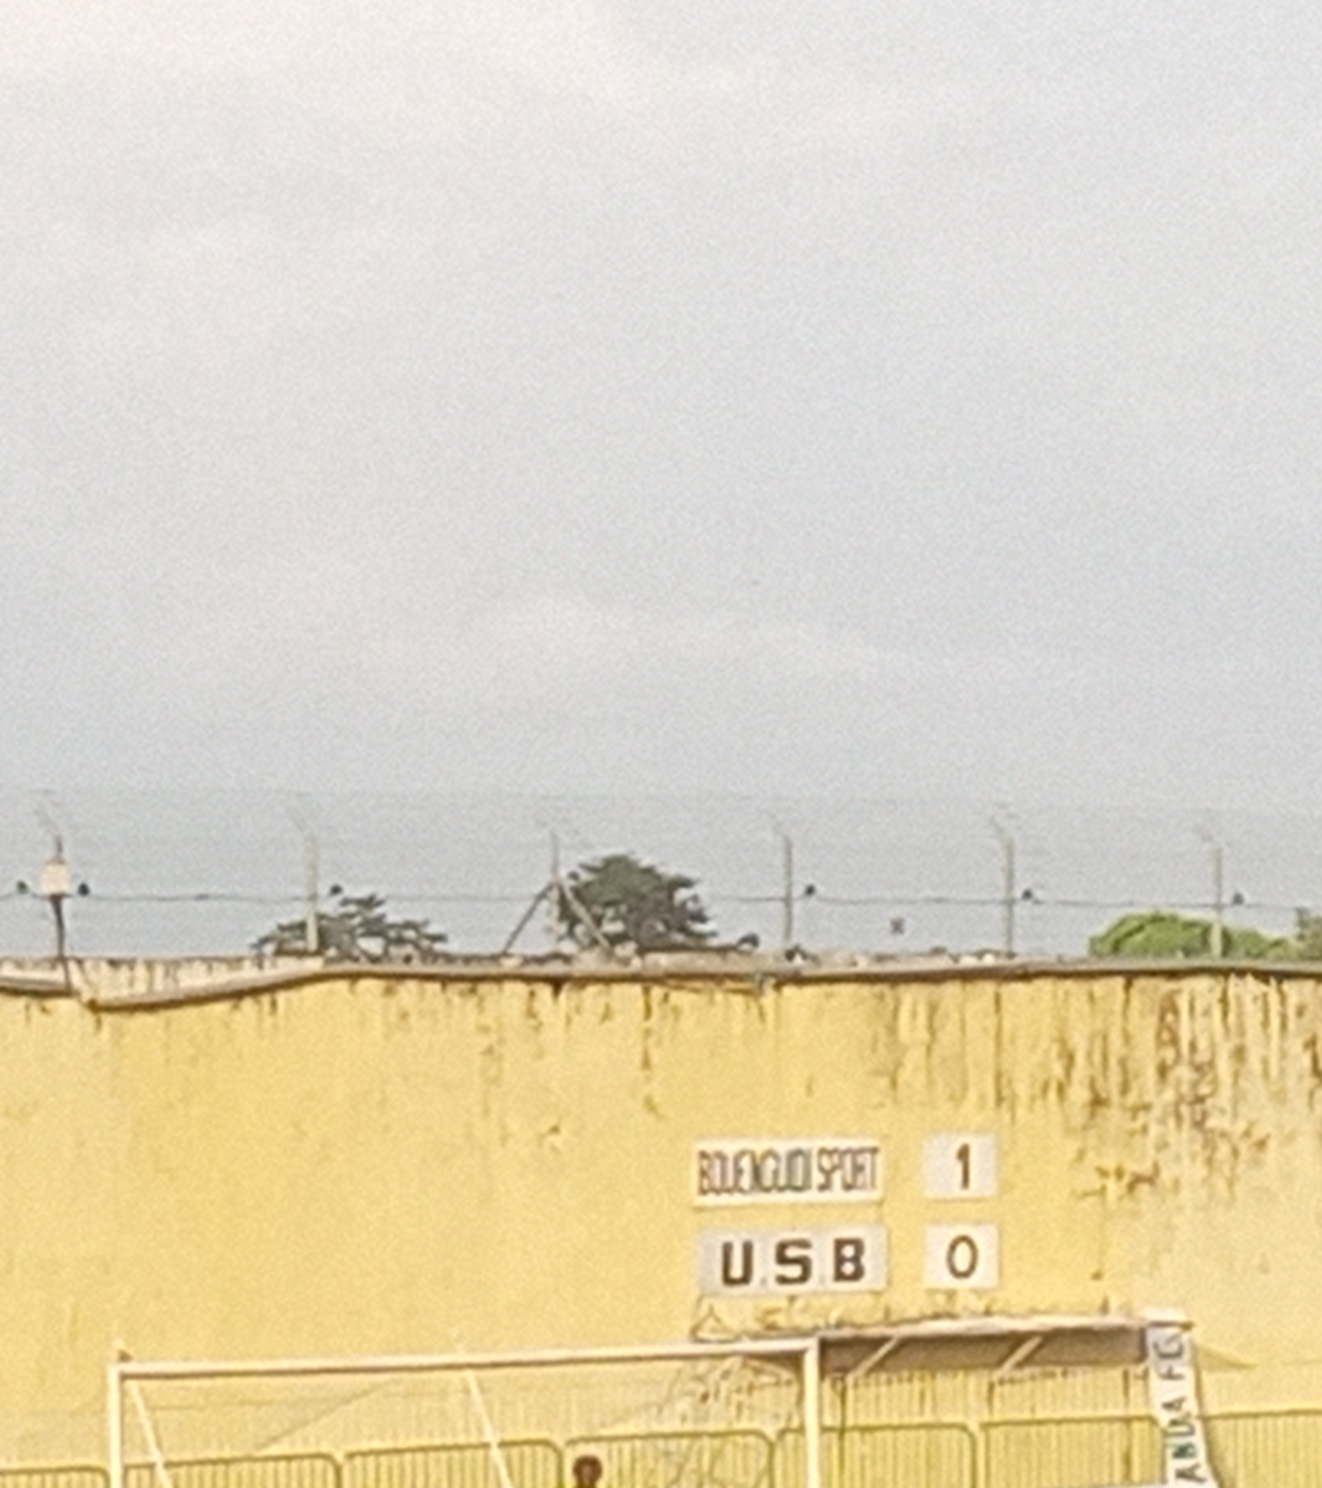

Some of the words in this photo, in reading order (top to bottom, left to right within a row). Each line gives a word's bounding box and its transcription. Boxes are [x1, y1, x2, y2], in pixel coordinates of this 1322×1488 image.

[817, 1146, 880, 1192] SPORT
[956, 1143, 971, 1190] 1
[946, 1234, 979, 1280] 0
